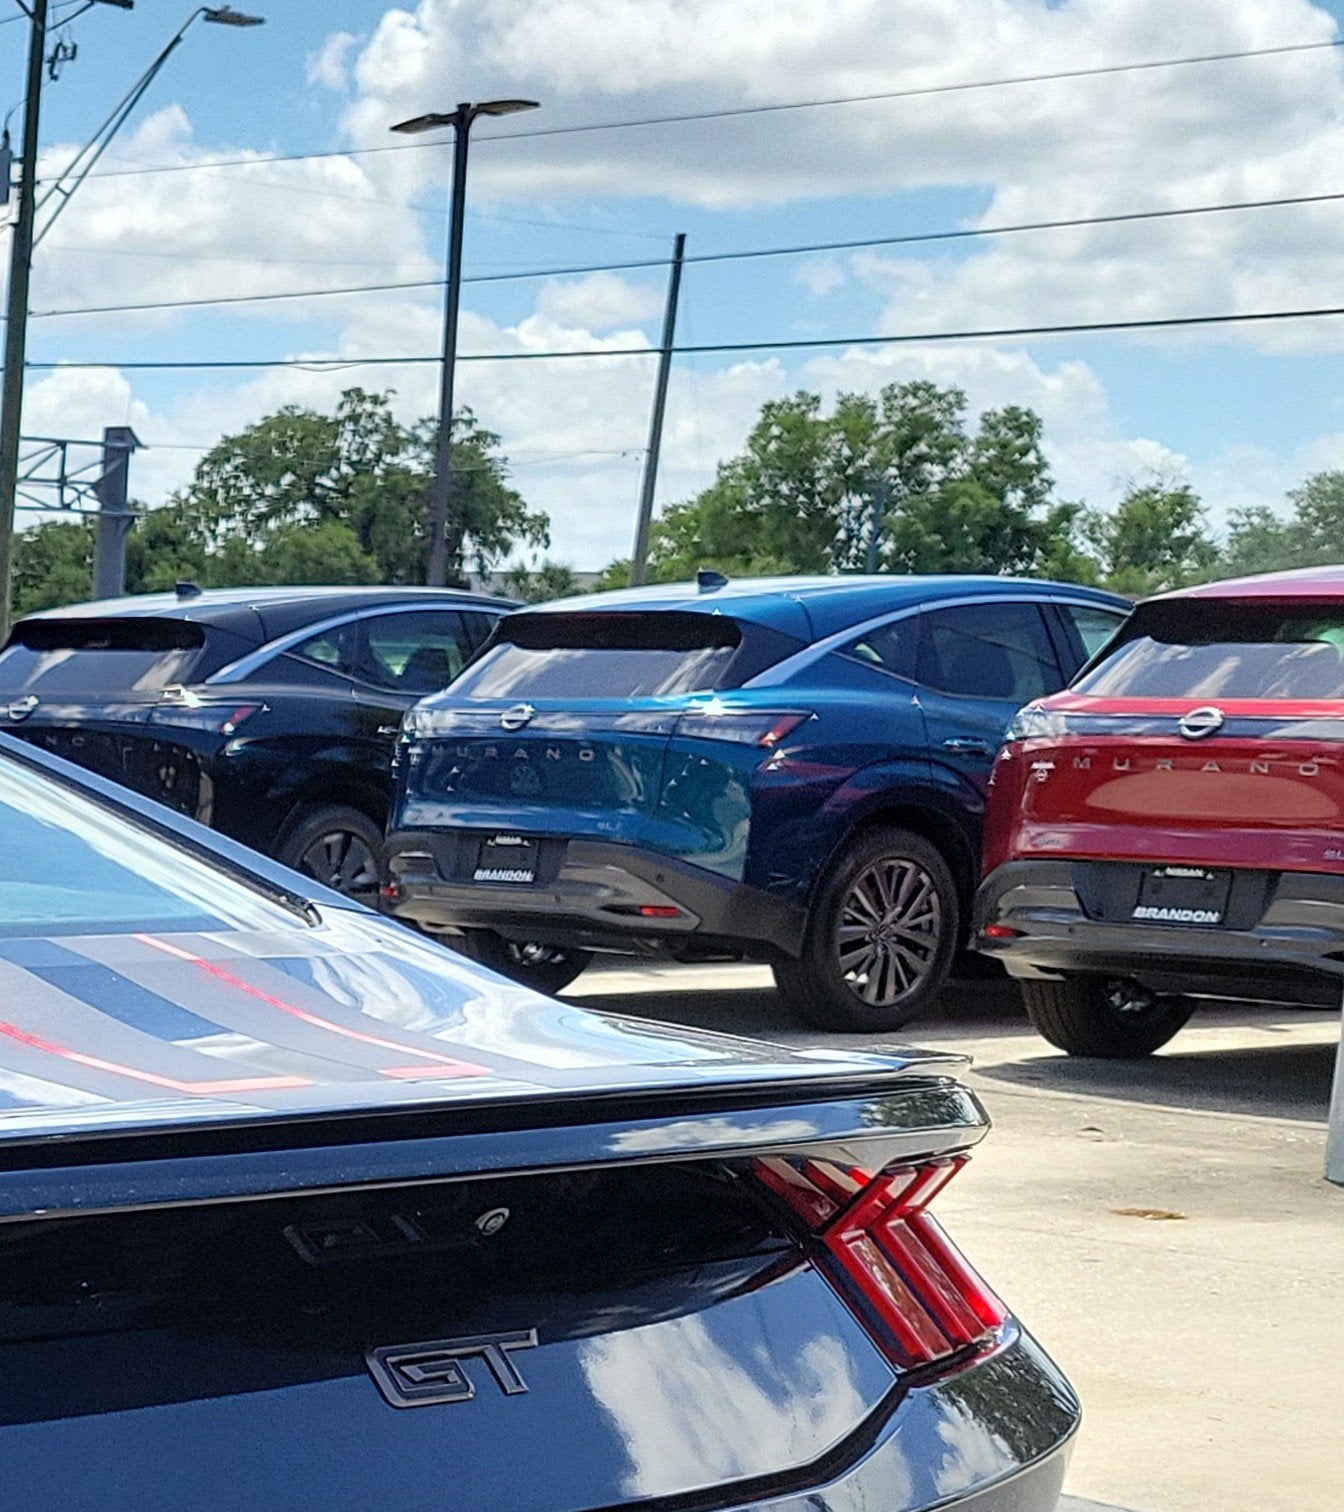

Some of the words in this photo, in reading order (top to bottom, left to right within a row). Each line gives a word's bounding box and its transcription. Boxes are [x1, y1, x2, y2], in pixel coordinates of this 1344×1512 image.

[1073, 757, 1319, 776] MURANO
[473, 868, 534, 882] BRANDON
[1132, 905, 1220, 923] BRANDON
[365, 1327, 539, 1409] GT
